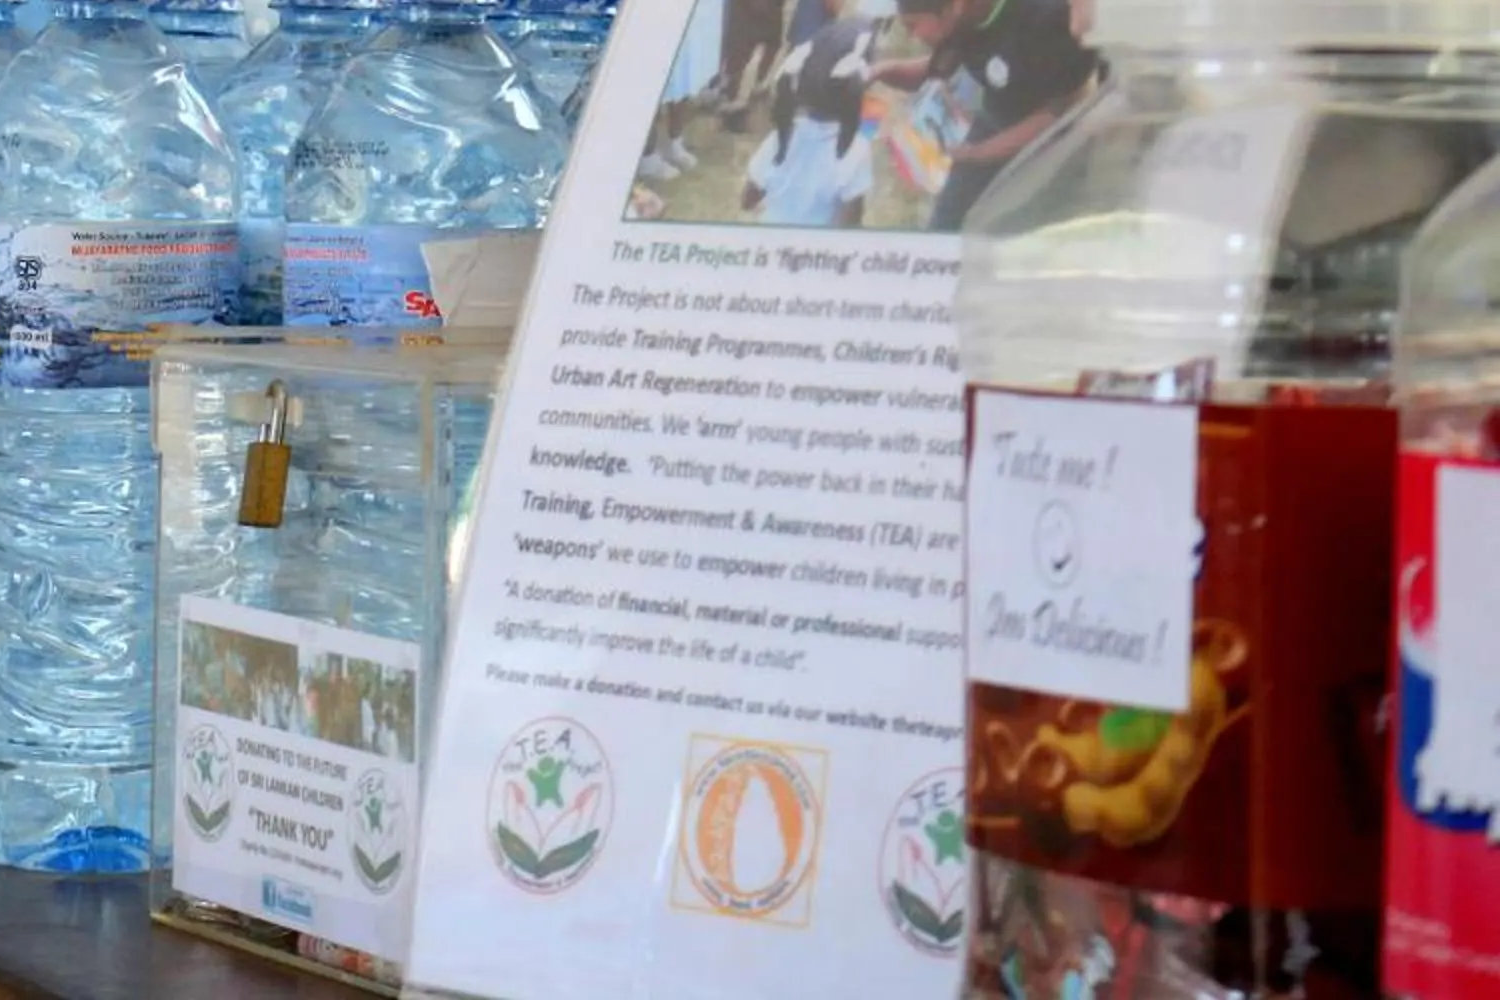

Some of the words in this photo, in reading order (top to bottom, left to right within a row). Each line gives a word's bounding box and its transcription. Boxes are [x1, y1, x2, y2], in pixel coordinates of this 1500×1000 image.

[611, 240, 644, 262] The
[649, 242, 681, 263] TEA
[685, 244, 750, 270] Project
[754, 245, 769, 267] is
[861, 250, 910, 274] child
[910, 257, 962, 279] pove
[572, 283, 604, 305] The
[608, 286, 670, 313] Project
[673, 289, 688, 310] is
[692, 292, 724, 313] not
[726, 293, 781, 315] about
[784, 296, 885, 320] short-term
[560, 327, 627, 349] provide
[632, 329, 703, 357] Training
[706, 332, 826, 363] Programmes,
[833, 341, 927, 365] Children's
[550, 364, 604, 386] Urban
[607, 367, 638, 389] Art
[641, 370, 761, 398] Regeneration
[765, 381, 786, 399] to
[790, 385, 884, 407] empower
[887, 386, 965, 412] vulnera
[538, 408, 654, 433] communities.
[662, 413, 691, 437] We
[746, 424, 804, 450] young
[807, 429, 873, 454] people
[878, 432, 921, 453] with
[528, 444, 632, 477] knowledge.
[721, 463, 751, 482] the
[755, 469, 815, 490] power
[819, 469, 862, 493] back
[867, 476, 887, 495] in
[891, 475, 938, 499] their
[521, 489, 595, 520] Training,
[601, 497, 736, 529] Empowerment
[740, 509, 755, 532] &
[760, 512, 865, 541] Awareness
[870, 521, 922, 551] (TEA)
[926, 530, 960, 550] are
[607, 546, 634, 565] we
[637, 548, 670, 567] use
[673, 549, 693, 570] to
[697, 556, 788, 578] empower
[790, 563, 868, 586] children
[871, 565, 923, 599] living
[927, 574, 948, 596] in
[522, 582, 594, 607] donation
[597, 588, 616, 610] of
[618, 592, 691, 621] financial,
[695, 603, 768, 627] material
[770, 613, 790, 629] or
[791, 613, 903, 642] professional
[493, 617, 586, 649] significantly
[587, 627, 655, 653] improve
[658, 635, 687, 658] the
[690, 638, 716, 661] life
[718, 643, 739, 662] of
[740, 649, 751, 665] a
[485, 662, 530, 685] Please
[532, 672, 573, 690] make
[573, 678, 585, 692] a
[586, 674, 653, 700] donation
[656, 687, 685, 703] and
[686, 693, 744, 712] contact
[745, 701, 764, 715] us
[767, 699, 791, 718] via
[794, 707, 823, 721] our
[825, 707, 887, 731] website
[236, 737, 281, 764] DONATING
[282, 748, 295, 768] TO
[296, 753, 313, 773] THE
[313, 756, 347, 782] FUTURE
[301, 786, 344, 812] CHILDREN
